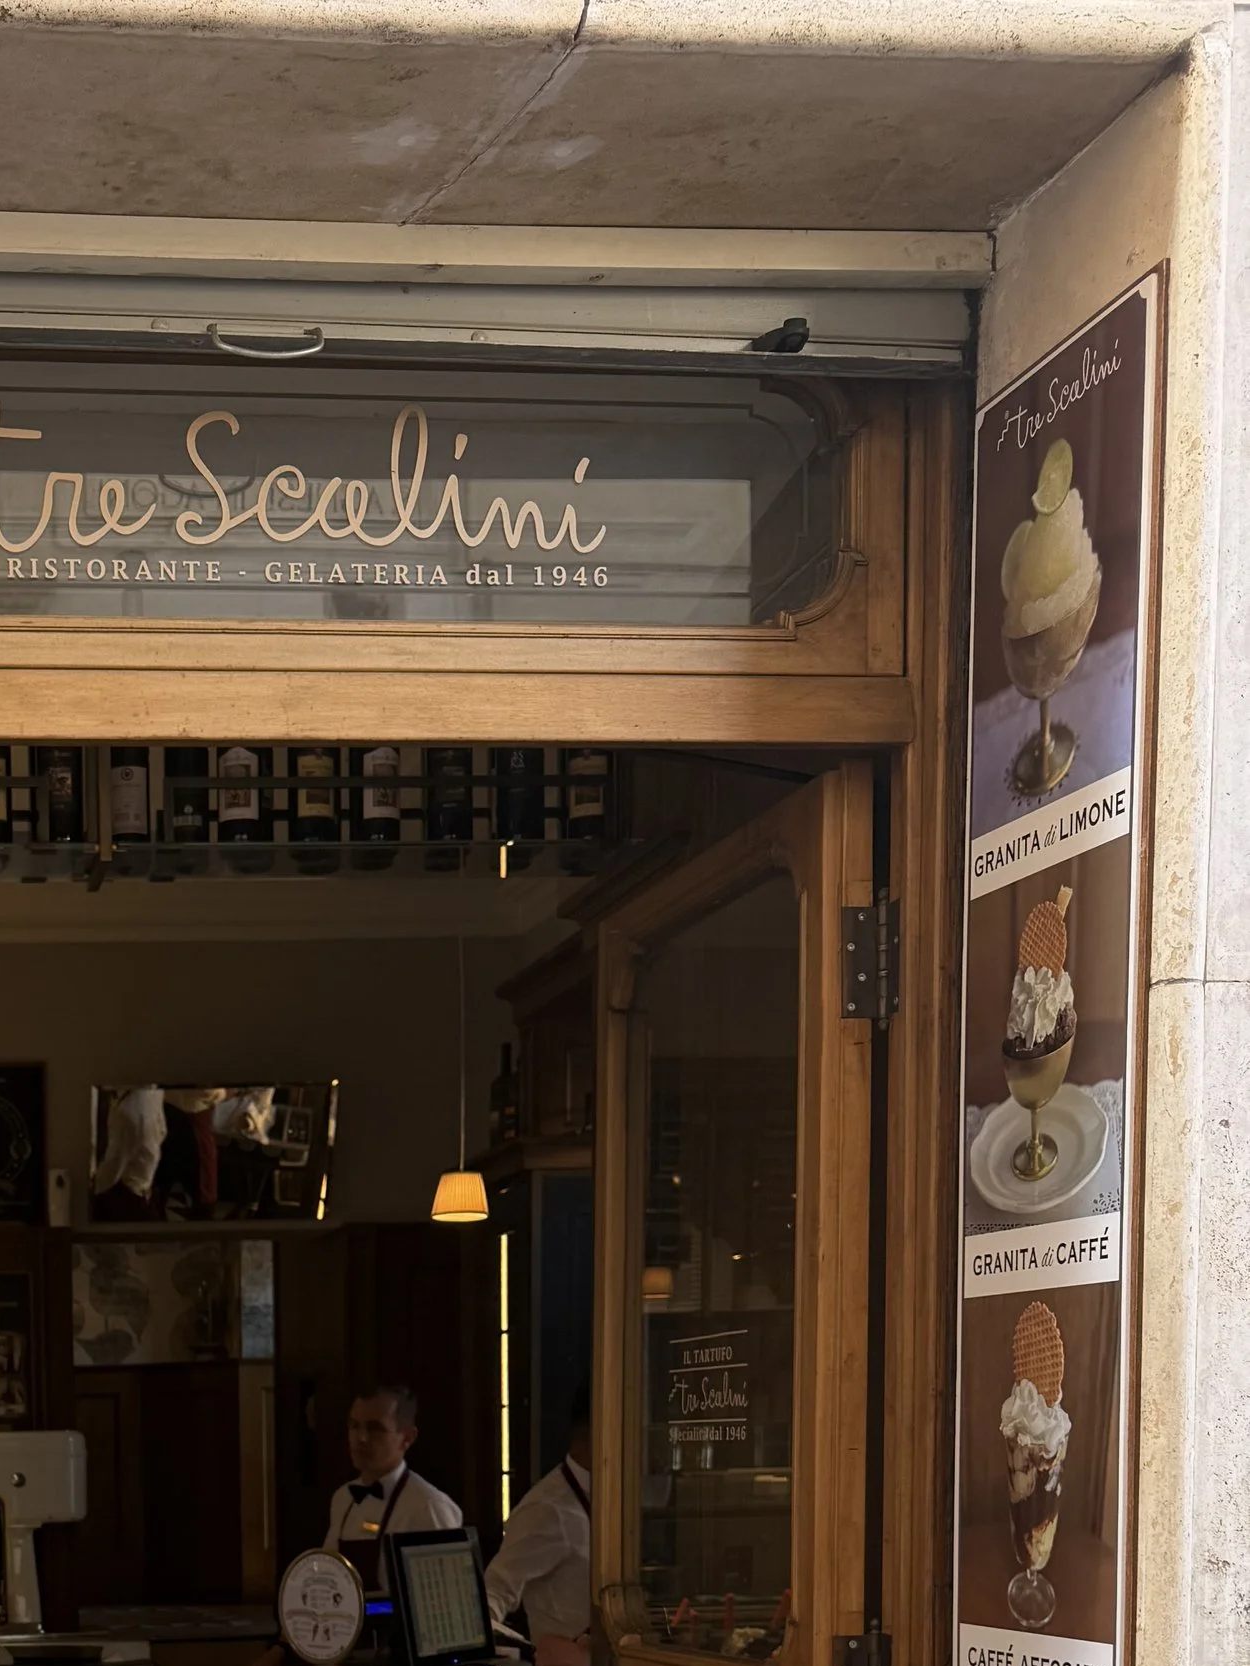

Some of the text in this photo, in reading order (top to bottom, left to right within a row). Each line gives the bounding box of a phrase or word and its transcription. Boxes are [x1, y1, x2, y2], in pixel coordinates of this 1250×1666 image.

[1047, 338, 1122, 423] Scalini
[176, 404, 607, 553] Scalini
[7, 557, 221, 582] RISTORANTE
[264, 562, 448, 586] GELATERIA
[466, 564, 514, 586] dal
[534, 566, 608, 587] 1946
[974, 789, 1126, 878] GRANITA di LIMONE
[973, 1227, 1109, 1276] GRANITA di CAFFÉ
[694, 1346, 733, 1364] TARTUFO
[726, 1425, 746, 1441] 1946
